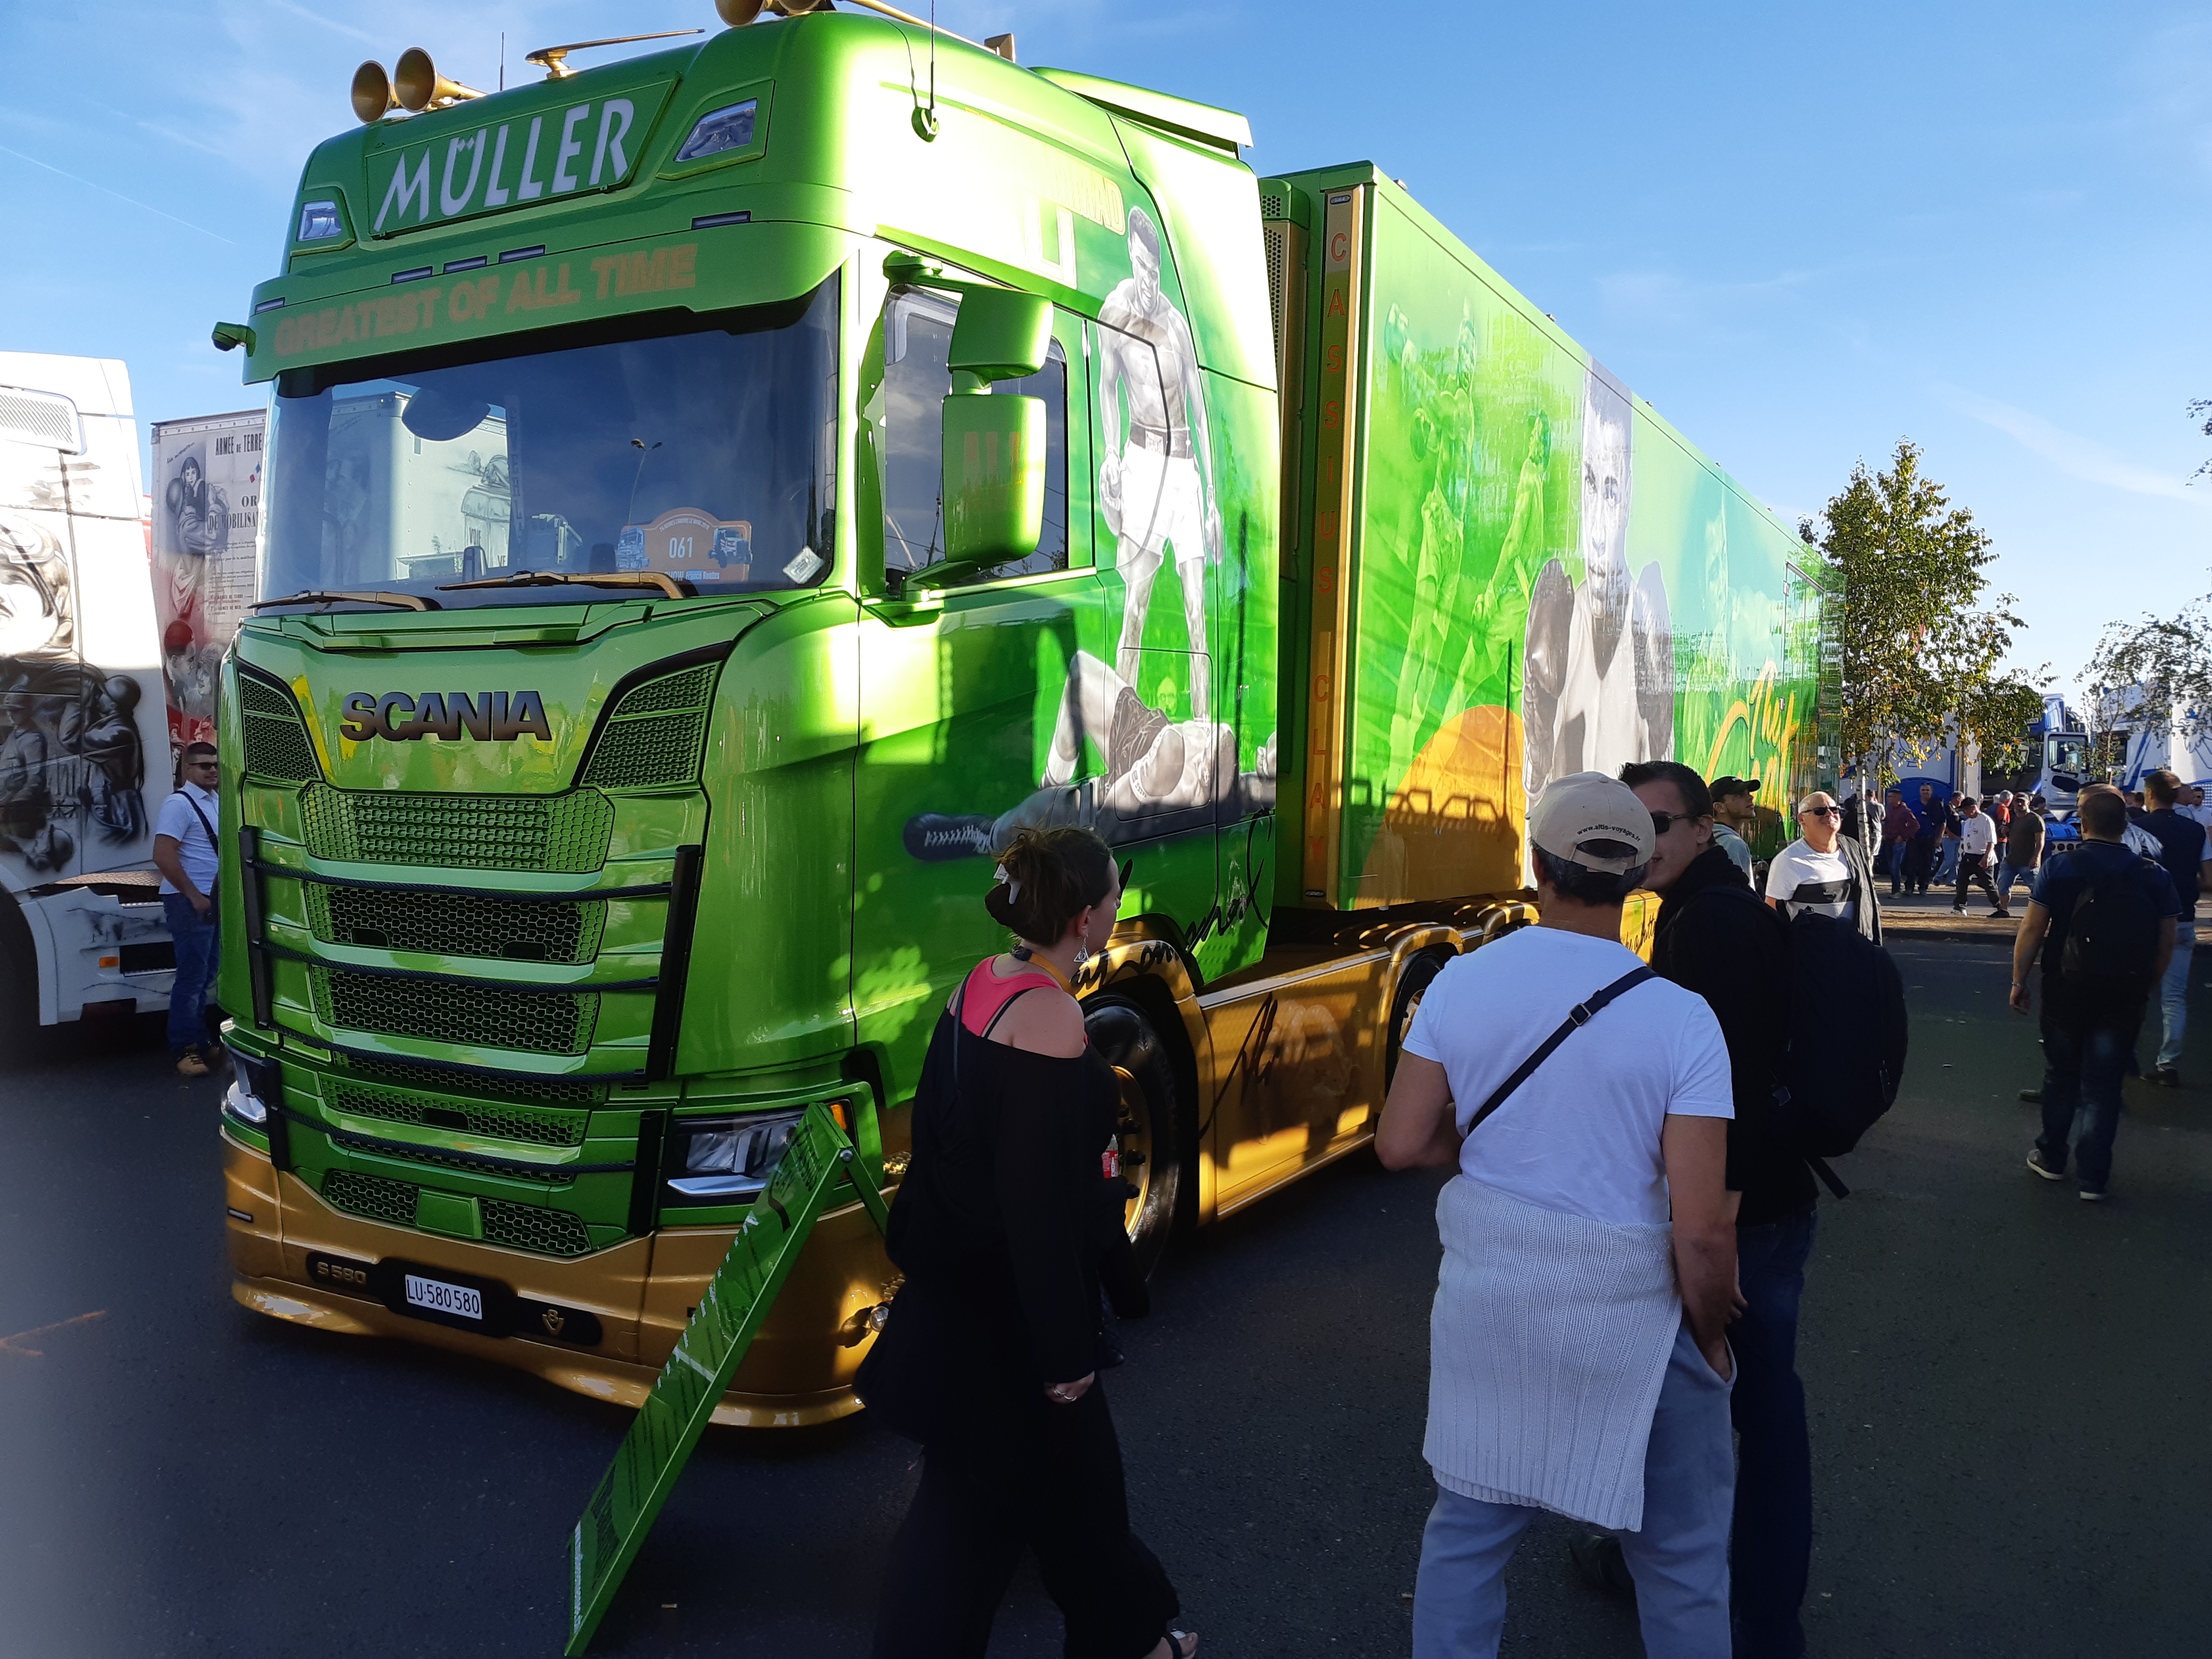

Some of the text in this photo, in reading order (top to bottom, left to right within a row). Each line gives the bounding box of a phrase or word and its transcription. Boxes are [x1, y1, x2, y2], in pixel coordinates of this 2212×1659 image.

[374, 98, 635, 231] MÜLLER
[274, 244, 698, 357] GREATEST OF ALL TIME
[1319, 232, 1347, 594] CASSIUS
[216, 433, 234, 456] ARMÉE
[236, 444, 241, 453] DE
[243, 433, 262, 452] TERRE
[669, 537, 693, 559] 061
[340, 691, 552, 741] SCANIA
[1577, 823, 1641, 842] www.altis-voyages.fr
[317, 1261, 367, 1285] S 580
